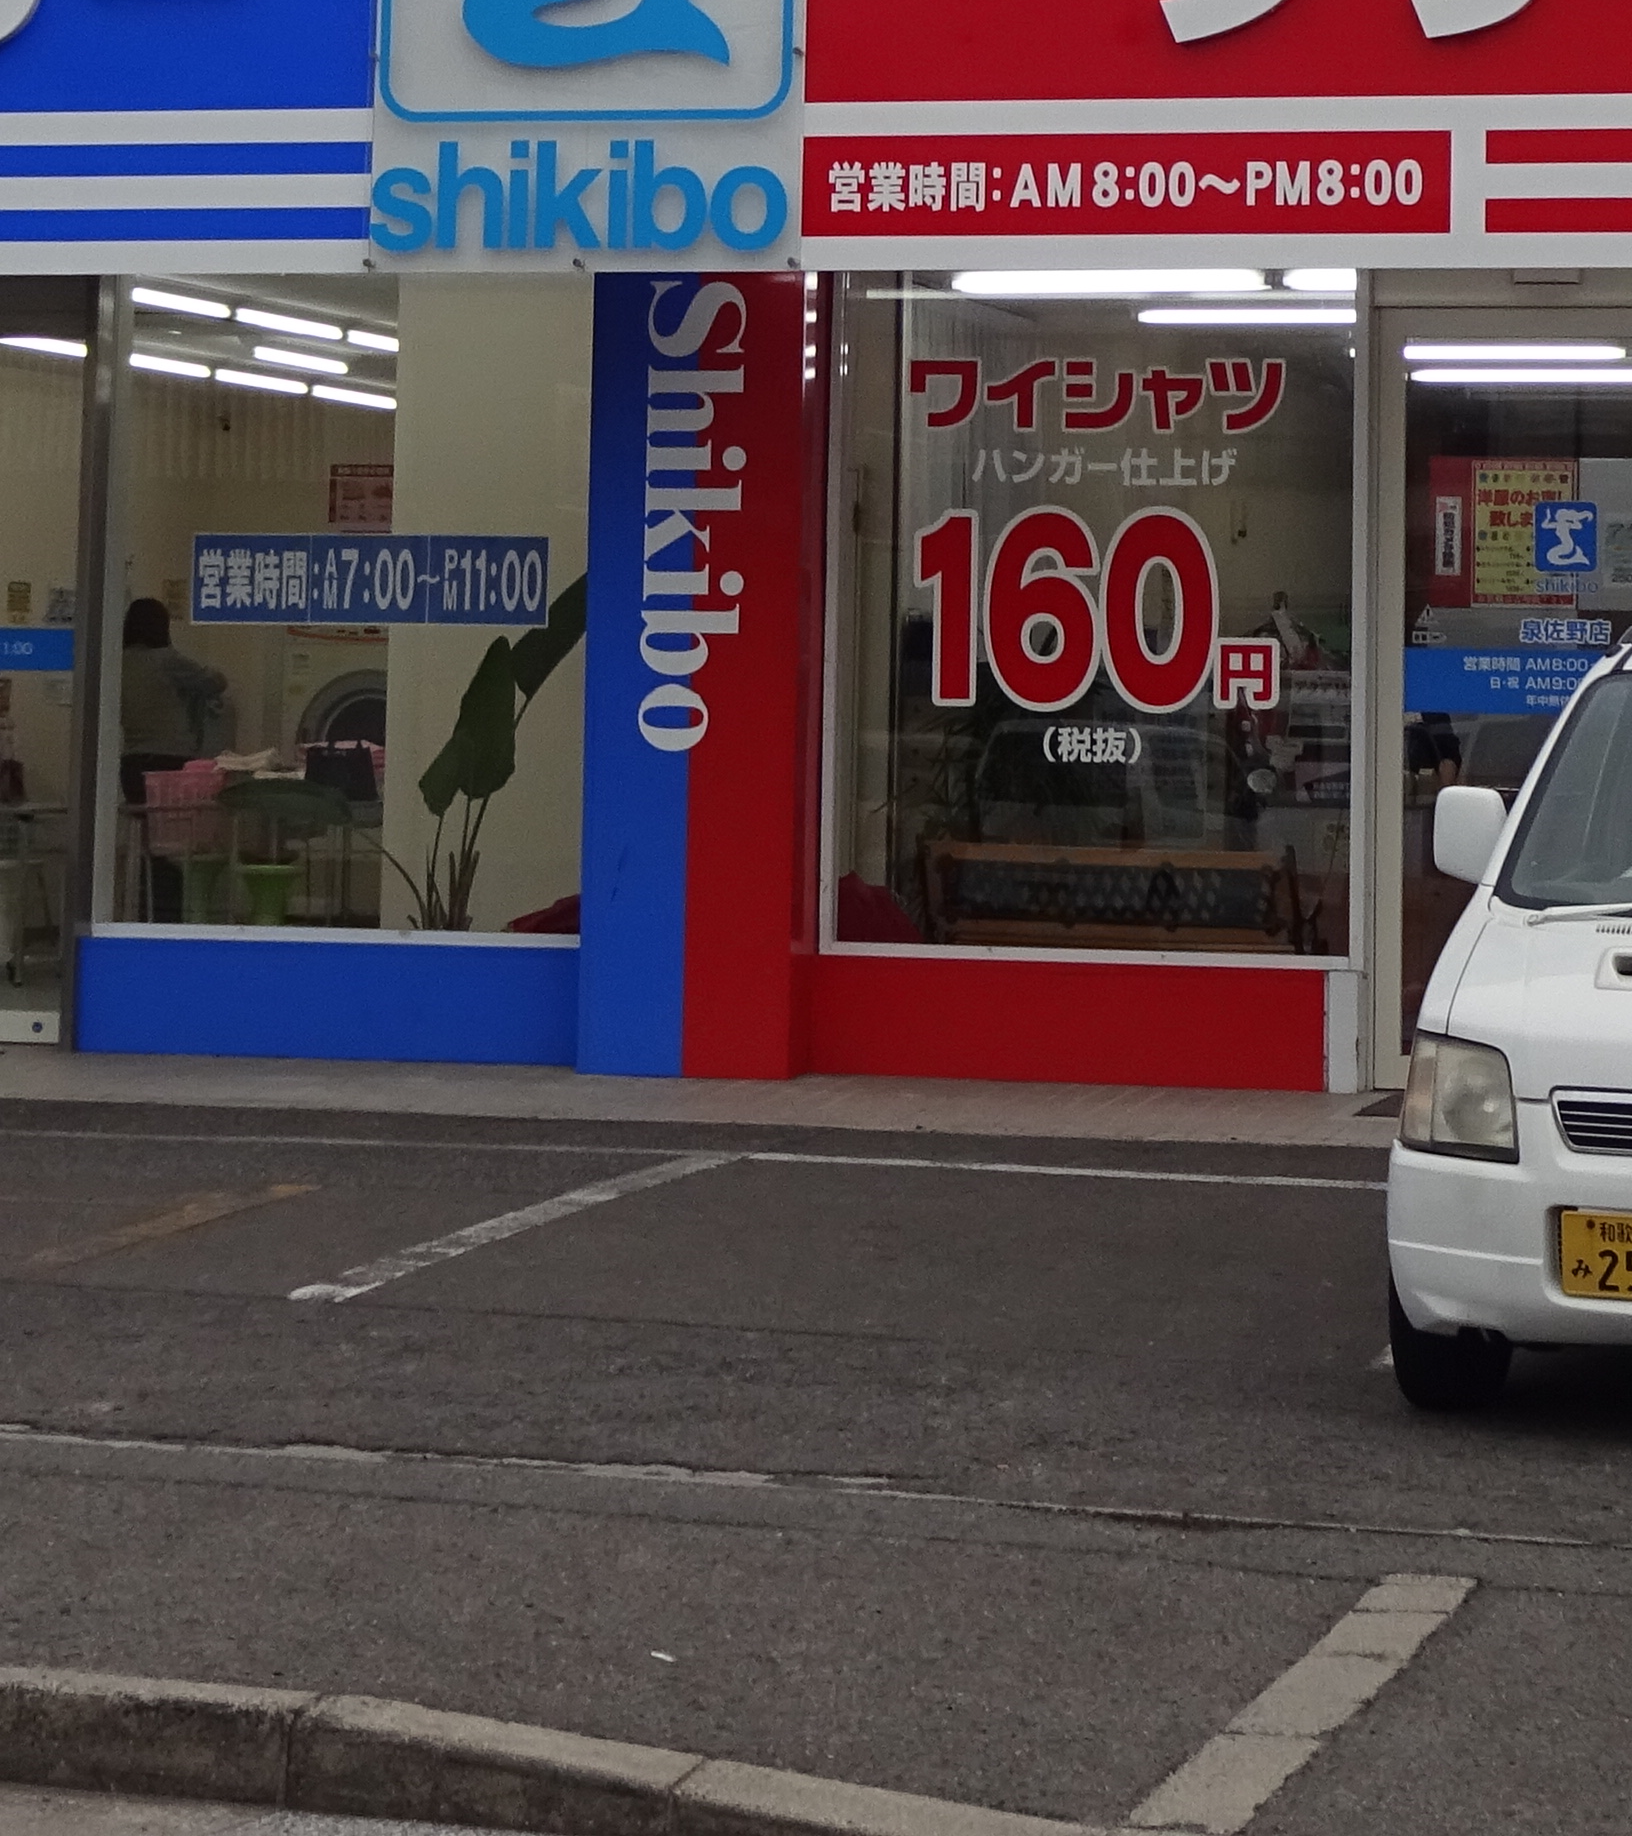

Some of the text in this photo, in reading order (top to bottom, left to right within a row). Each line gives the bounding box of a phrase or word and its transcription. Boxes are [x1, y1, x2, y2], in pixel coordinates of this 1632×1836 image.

[370, 138, 790, 254] shikibo
[909, 358, 1286, 434] ワイシャツ
[971, 448, 1238, 486] ハンガー仕上げ
[637, 280, 748, 752] Shikibo
[1534, 576, 1600, 594] shikibo
[913, 504, 1280, 713] 160円
[1520, 618, 1612, 644] 泉佐野店
[1463, 656, 1521, 672] 営業時間
[1042, 726, 1142, 764] (税抜)
[1571, 1258, 1594, 1279] み
